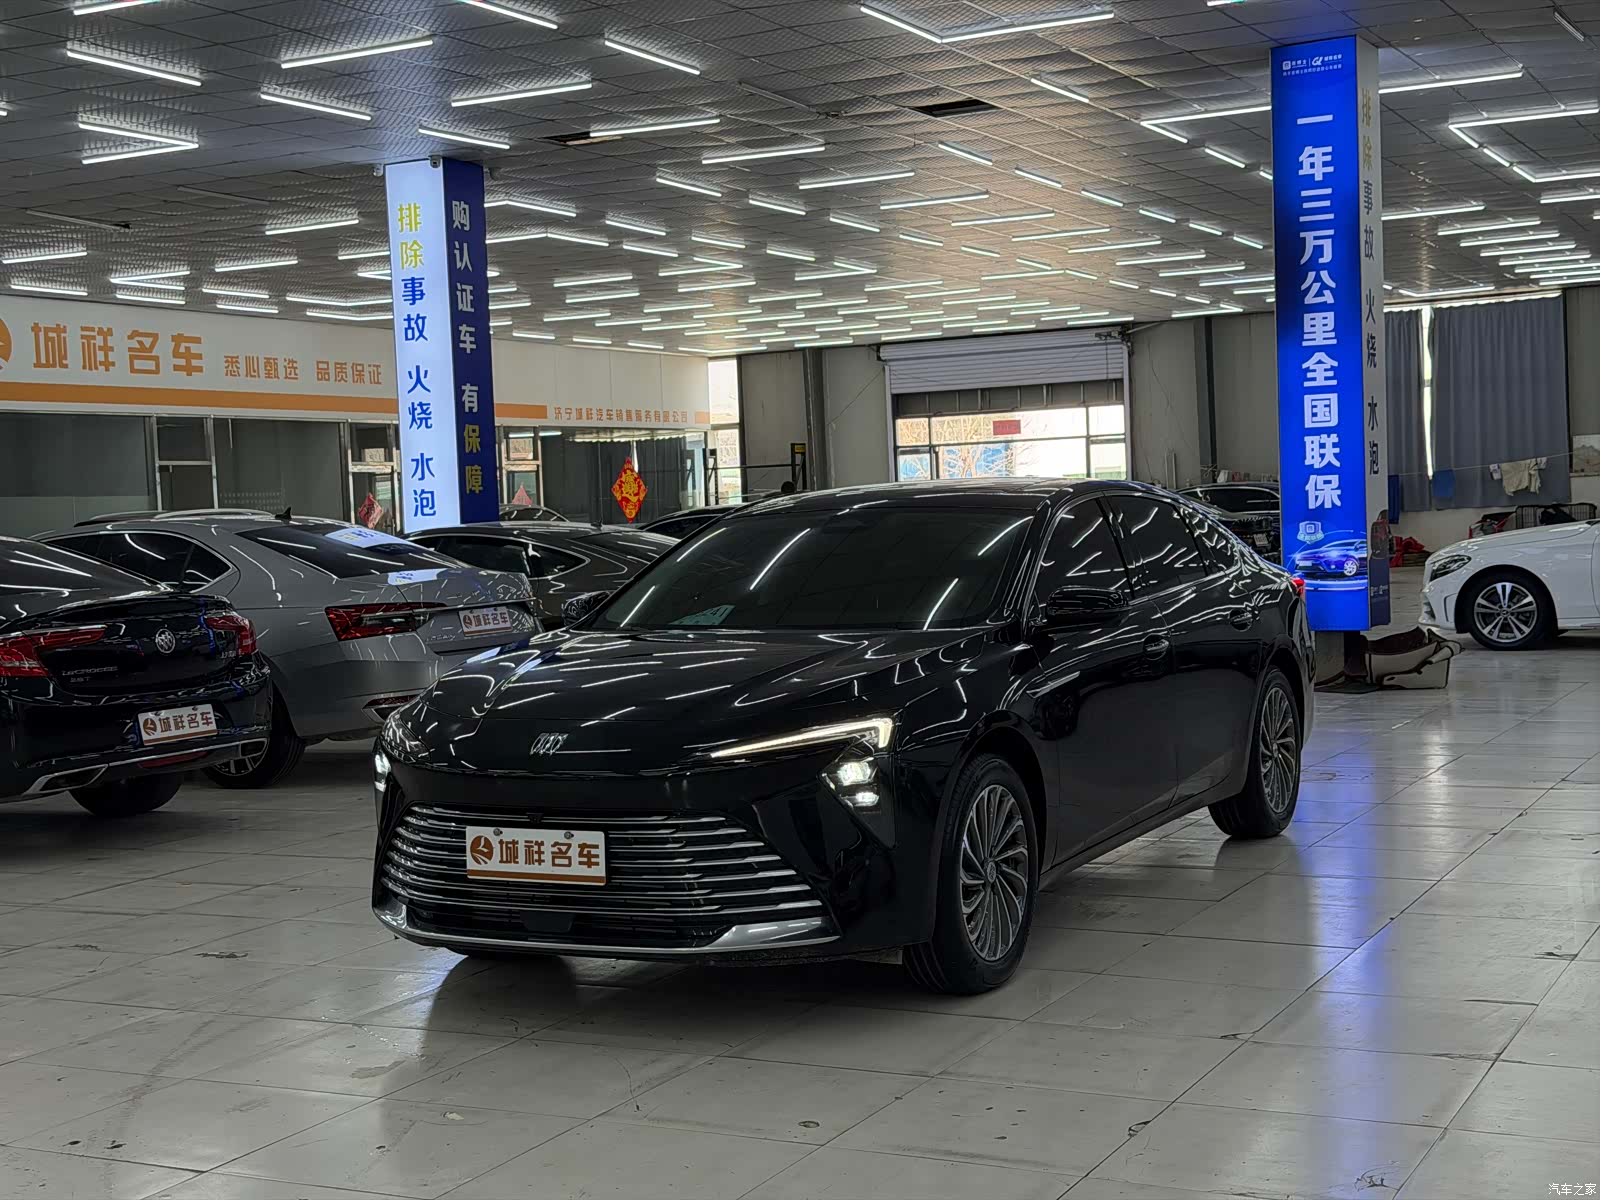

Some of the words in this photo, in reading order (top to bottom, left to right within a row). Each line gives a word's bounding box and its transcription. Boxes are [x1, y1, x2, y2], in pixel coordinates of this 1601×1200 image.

[1361, 87, 1375, 261] 排除事故
[397, 203, 429, 342] 排除事故
[451, 200, 478, 354] 购认证车
[1297, 114, 1342, 510] 一年三万公里全国联保
[1365, 287, 1378, 369] 火烧
[31, 322, 205, 377] 城祥名车
[223, 354, 300, 381] 悉心甄选
[315, 360, 383, 385] 品质保证
[407, 364, 433, 431] 火烧
[461, 383, 484, 494] 有保障
[1367, 395, 1379, 475] 水泡
[410, 452, 437, 518] 水泡
[473, 612, 509, 627] 城祥名车
[158, 711, 214, 734] 城祥名车
[498, 839, 600, 869] 城祥名车
